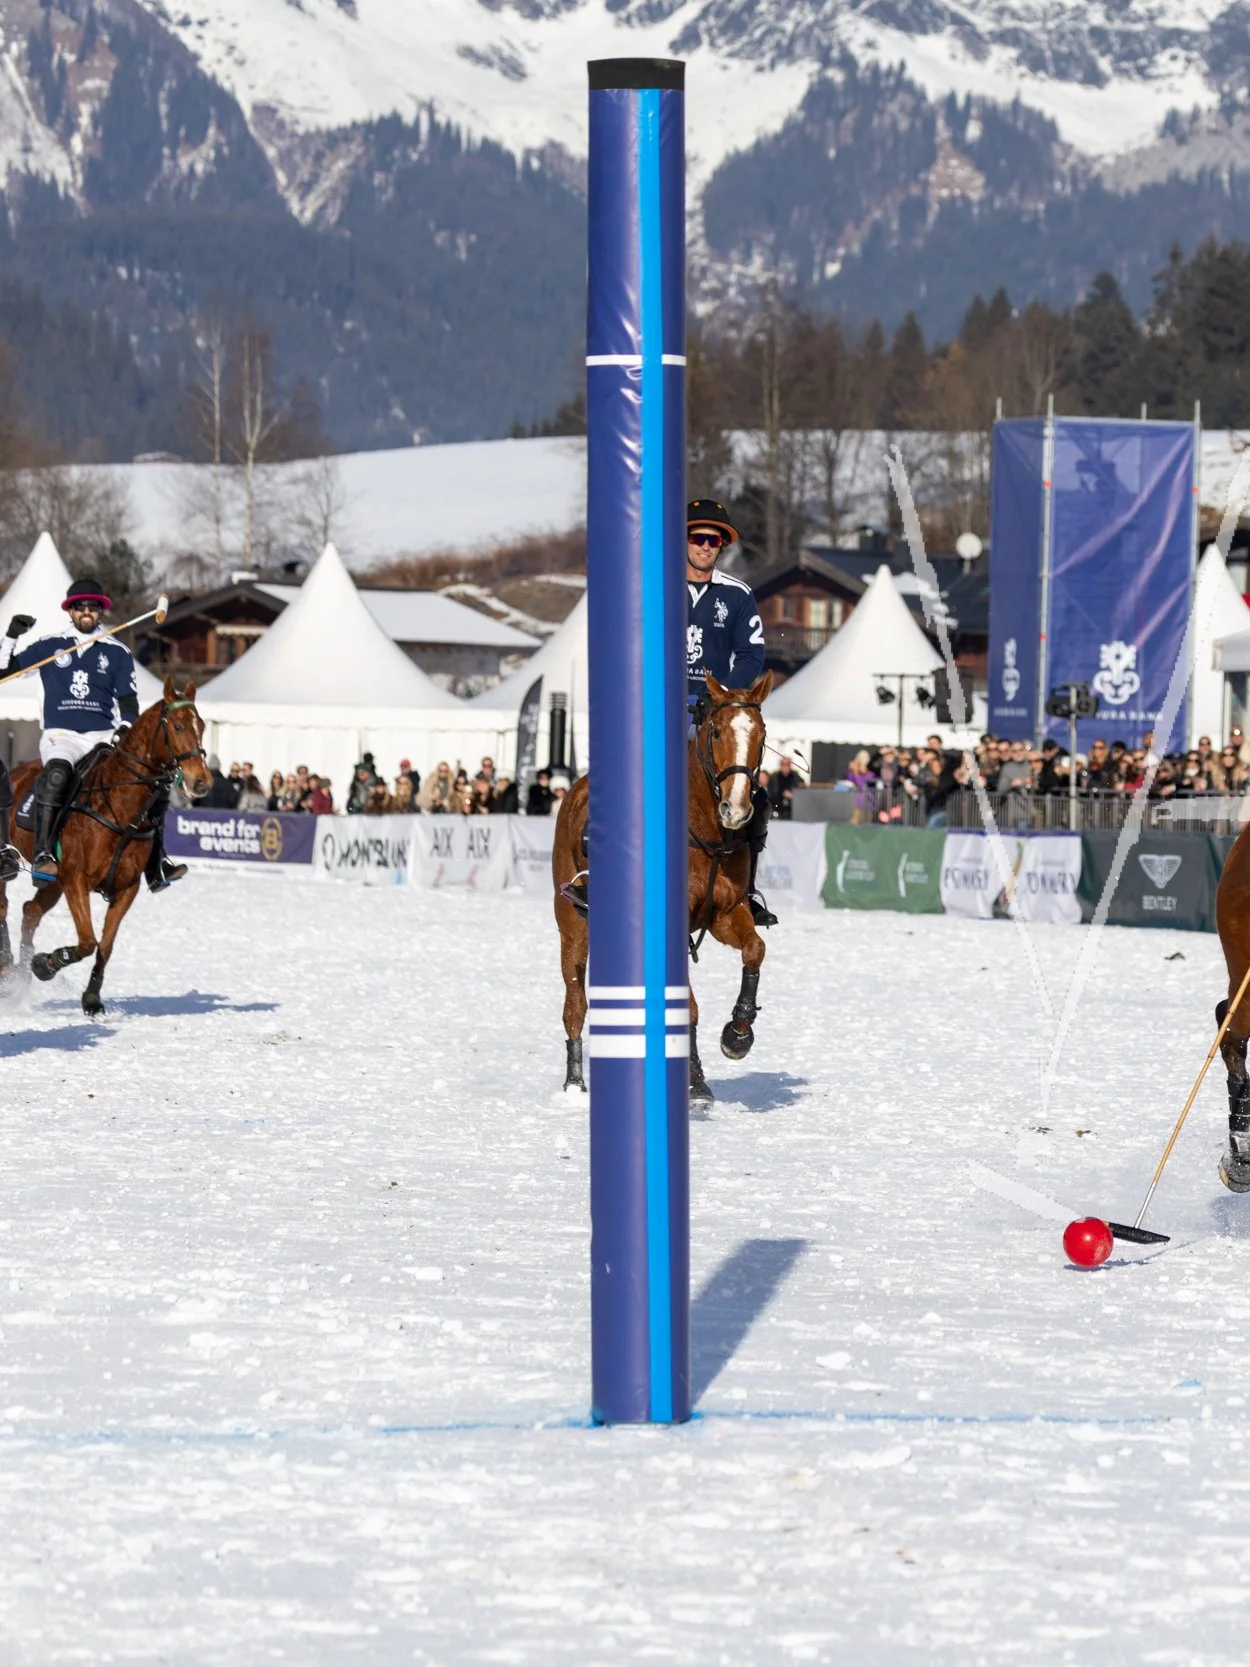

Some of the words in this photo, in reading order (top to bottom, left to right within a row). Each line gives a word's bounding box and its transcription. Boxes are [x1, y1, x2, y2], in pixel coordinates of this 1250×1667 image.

[749, 614, 765, 645] 2
[177, 815, 236, 837] brand
[237, 818, 261, 838] for
[199, 835, 261, 854] events
[1142, 895, 1177, 912] BENTLEY
